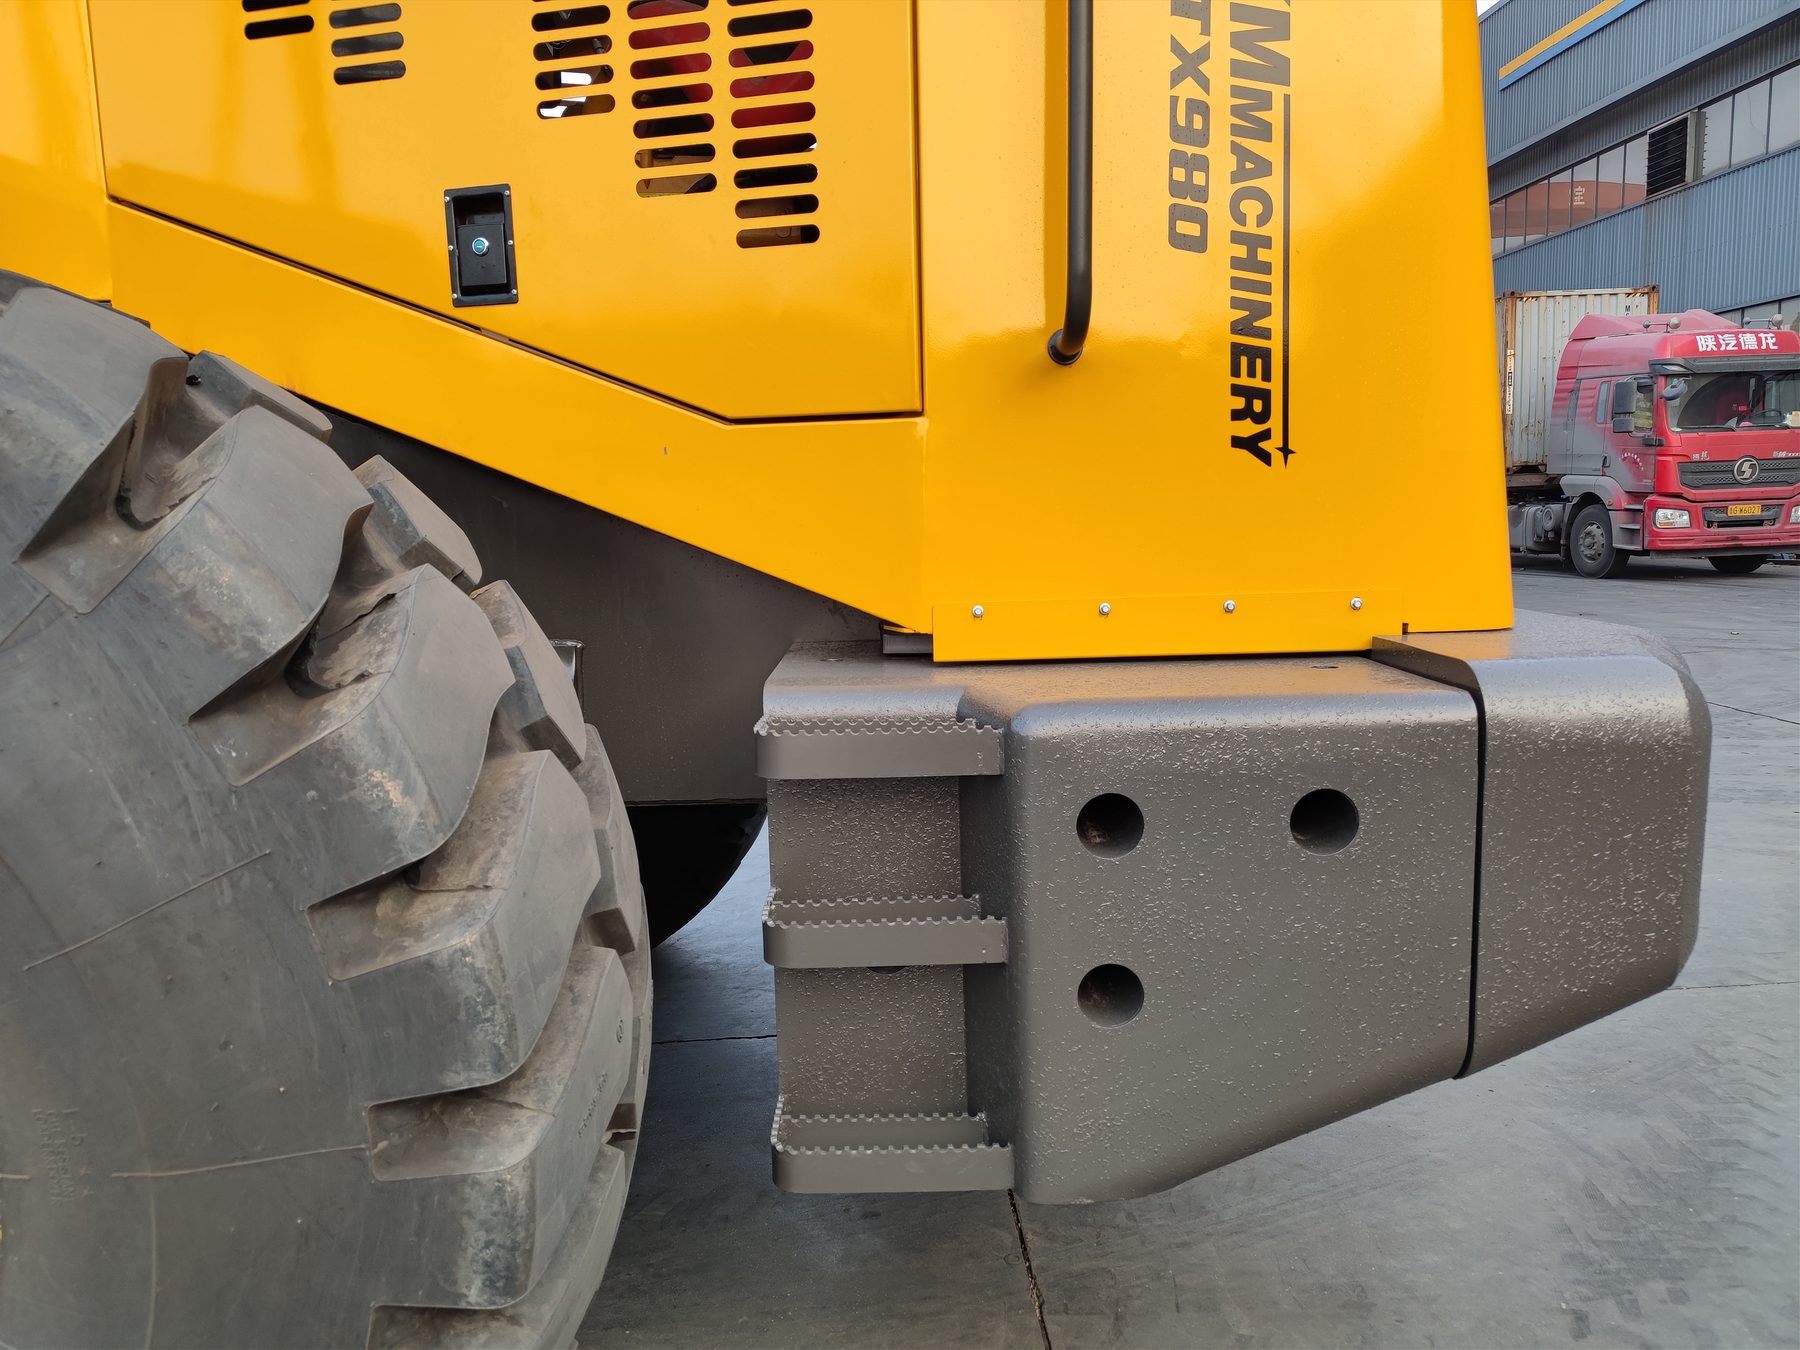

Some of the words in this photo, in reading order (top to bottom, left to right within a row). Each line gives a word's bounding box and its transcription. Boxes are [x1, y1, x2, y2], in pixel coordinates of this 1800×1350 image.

[1230, 0, 1290, 87] M
[1230, 84, 1274, 467] MACHINERY
[1696, 333, 1778, 352] 陕汽德龙
